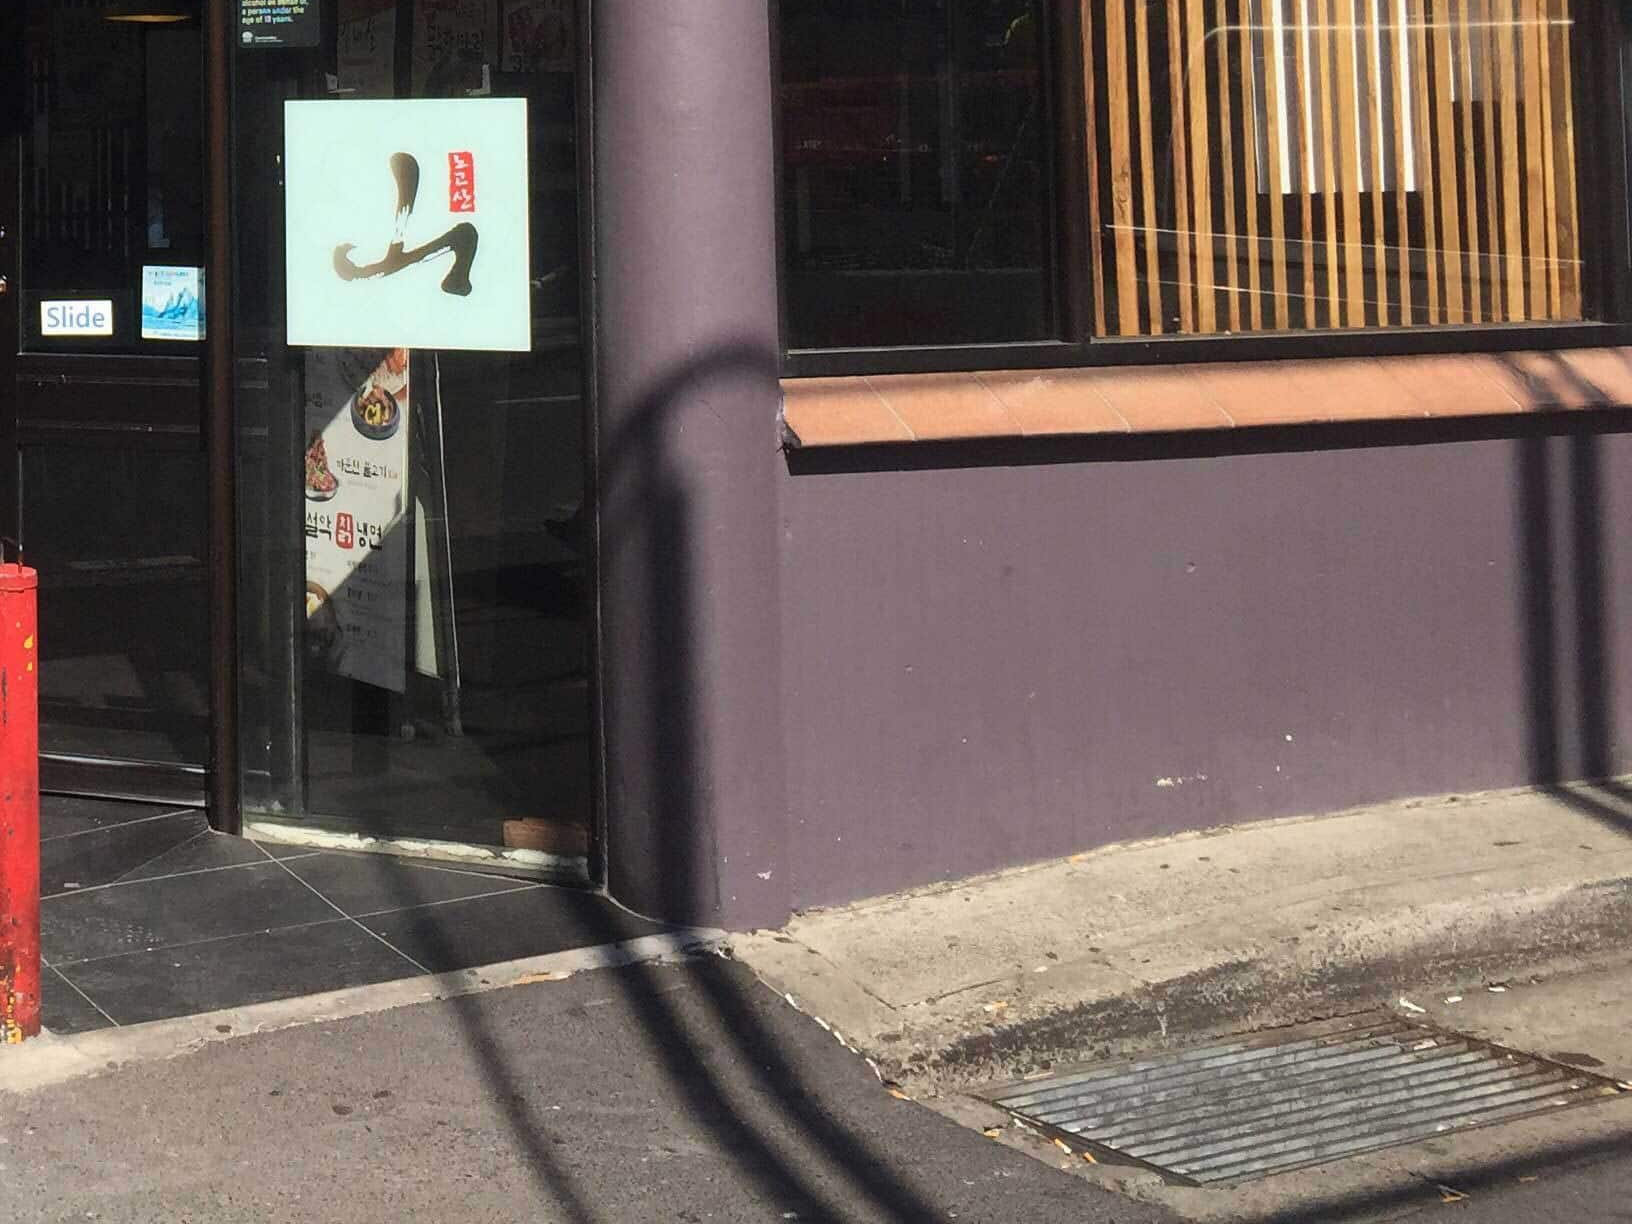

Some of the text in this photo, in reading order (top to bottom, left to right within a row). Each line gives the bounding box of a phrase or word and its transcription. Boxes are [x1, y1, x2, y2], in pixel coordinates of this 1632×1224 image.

[450, 153, 475, 212] 노고산
[46, 305, 105, 329] Slide
[356, 521, 383, 552] 냉면
